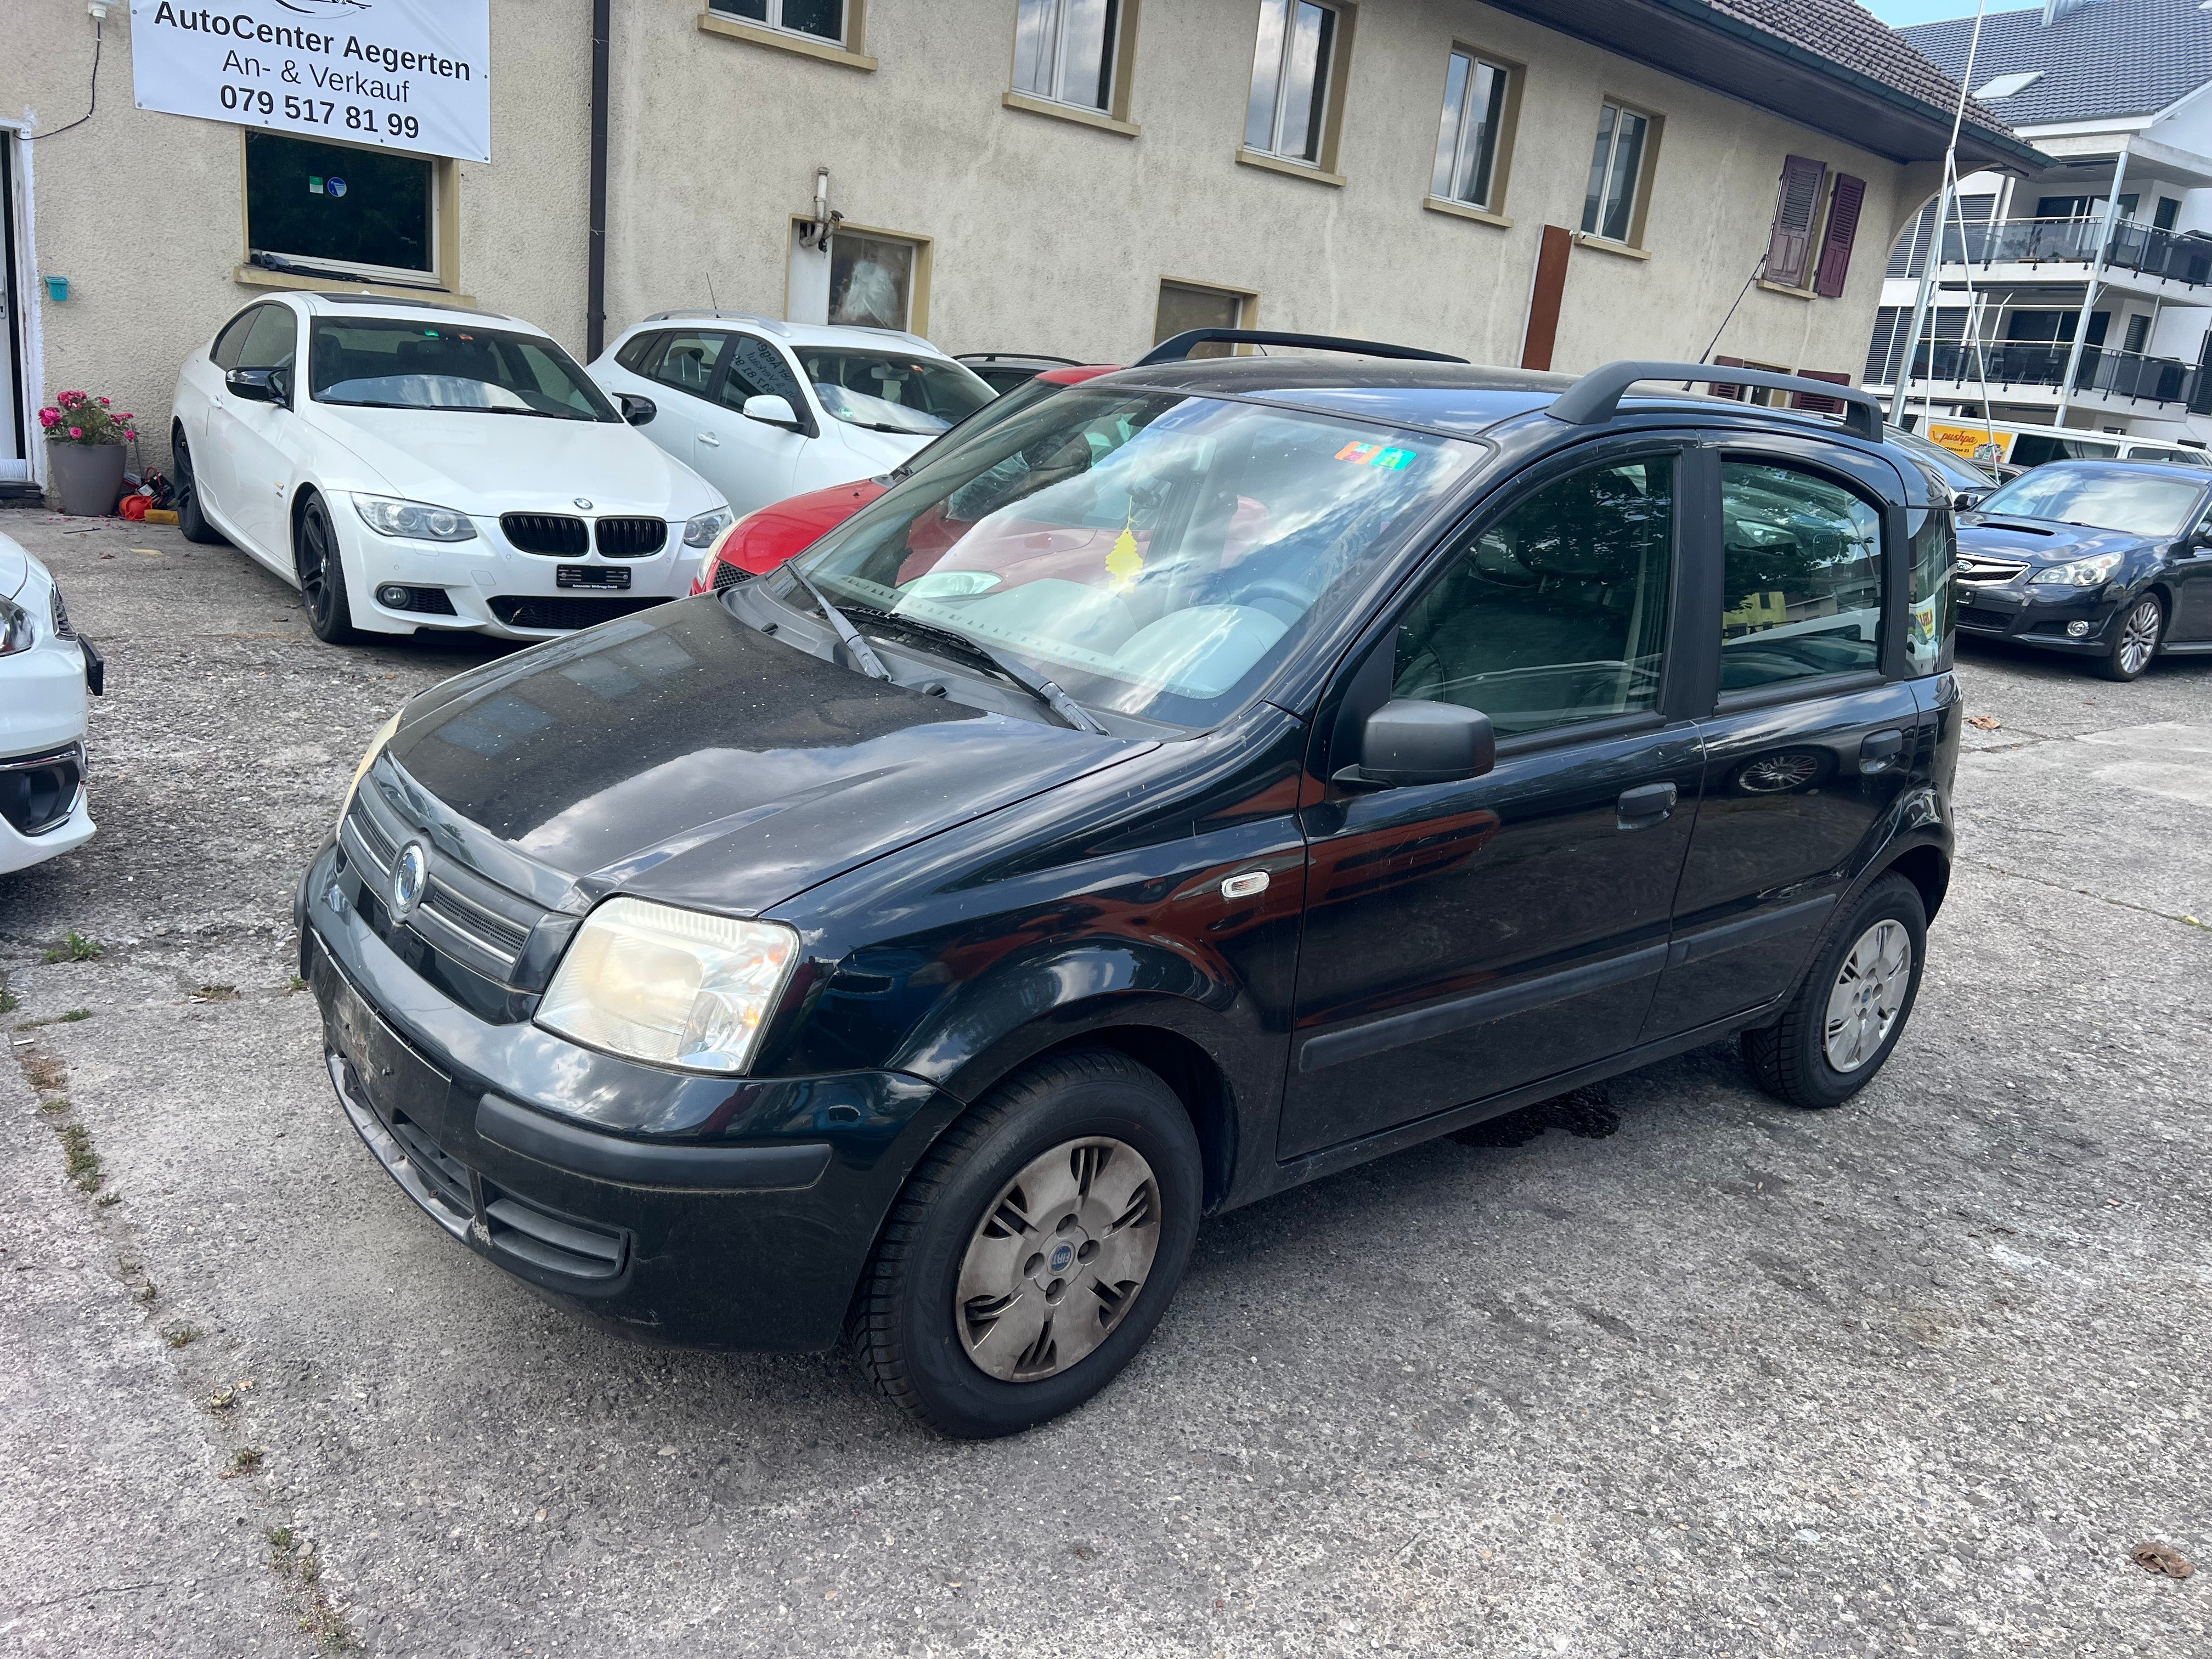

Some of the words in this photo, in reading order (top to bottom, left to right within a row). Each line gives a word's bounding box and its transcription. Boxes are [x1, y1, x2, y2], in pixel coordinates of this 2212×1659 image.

[154, 1, 334, 54] AutoCenter
[343, 36, 470, 81] Aegerten
[222, 49, 271, 77] An-
[280, 59, 301, 84] &
[308, 63, 410, 103] Verkauf
[220, 84, 274, 115] 079
[284, 95, 335, 125] 517
[345, 106, 379, 133] 81
[387, 114, 419, 139] 99
[1939, 431, 1976, 445] pushpa
[1052, 1251, 1070, 1265] FIAT
